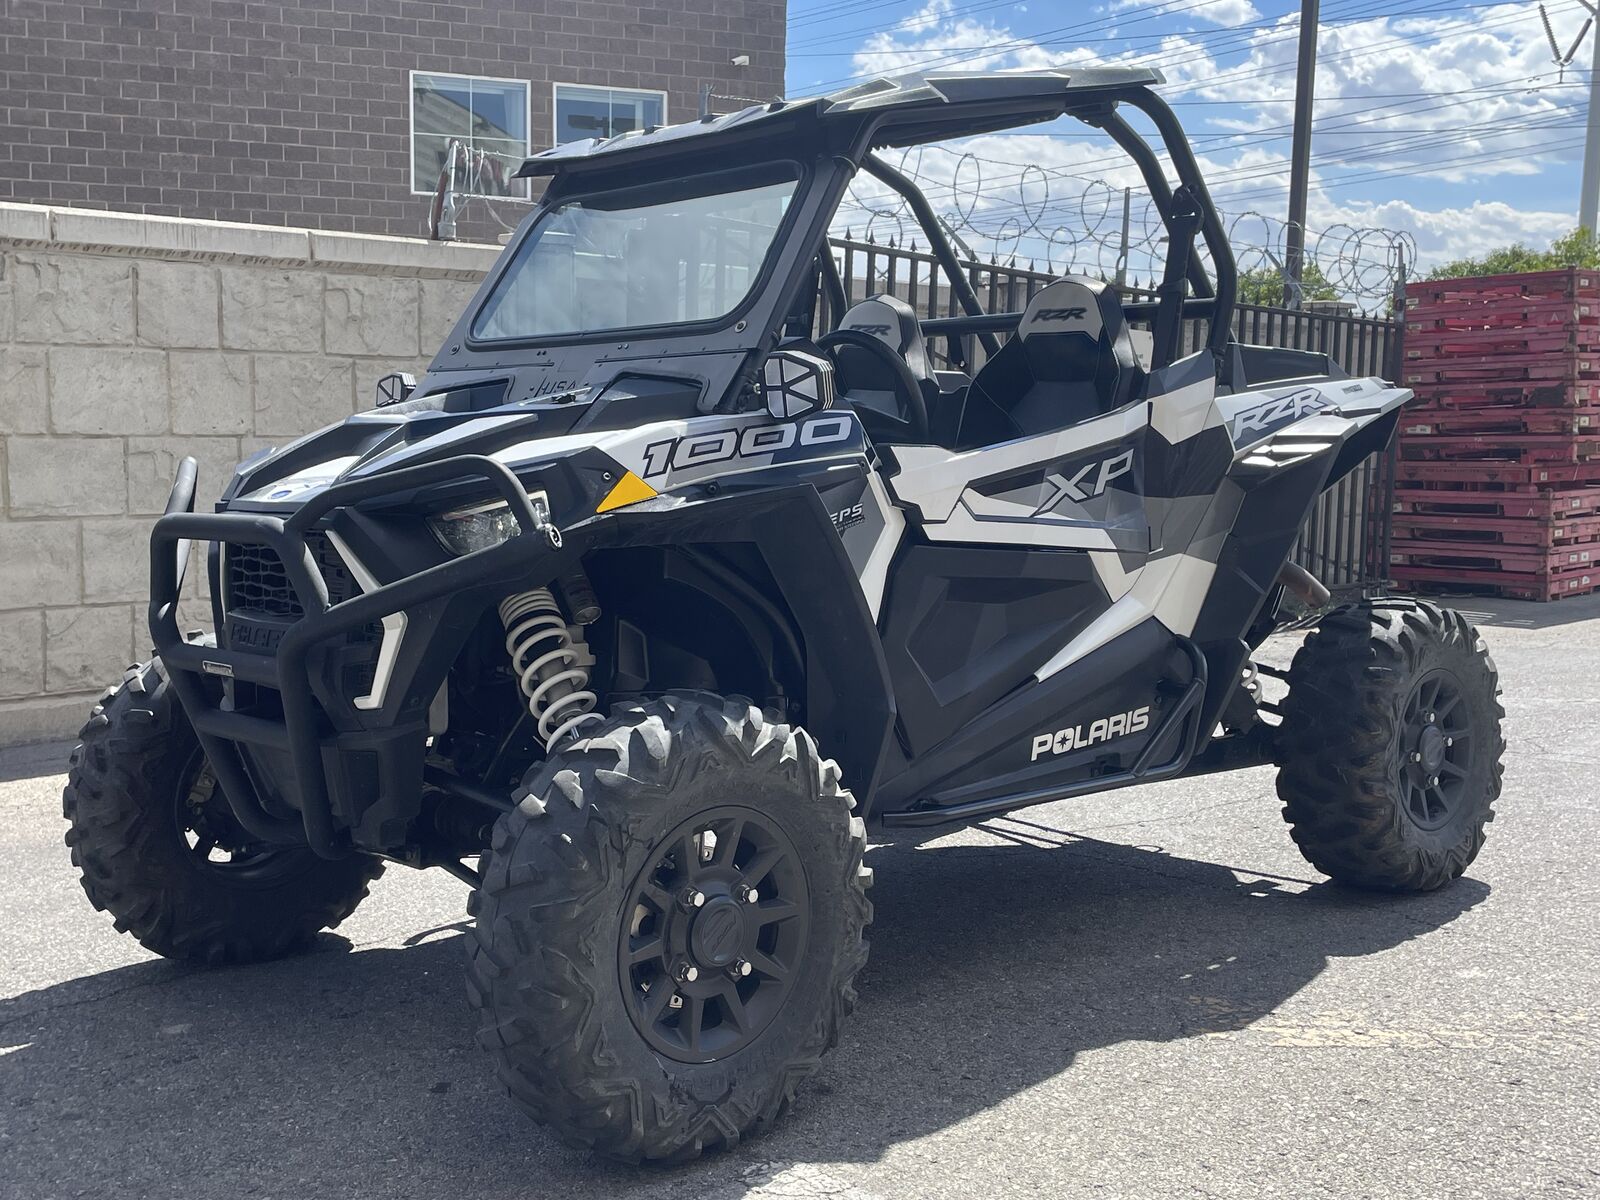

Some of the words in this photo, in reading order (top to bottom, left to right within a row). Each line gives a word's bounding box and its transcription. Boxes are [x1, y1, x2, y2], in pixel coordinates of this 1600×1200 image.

[1031, 307, 1088, 324] RZR
[1232, 387, 1329, 443] RZR
[642, 416, 853, 479] 1000
[1032, 448, 1135, 517] XP
[1030, 705, 1151, 762] POLARIS
